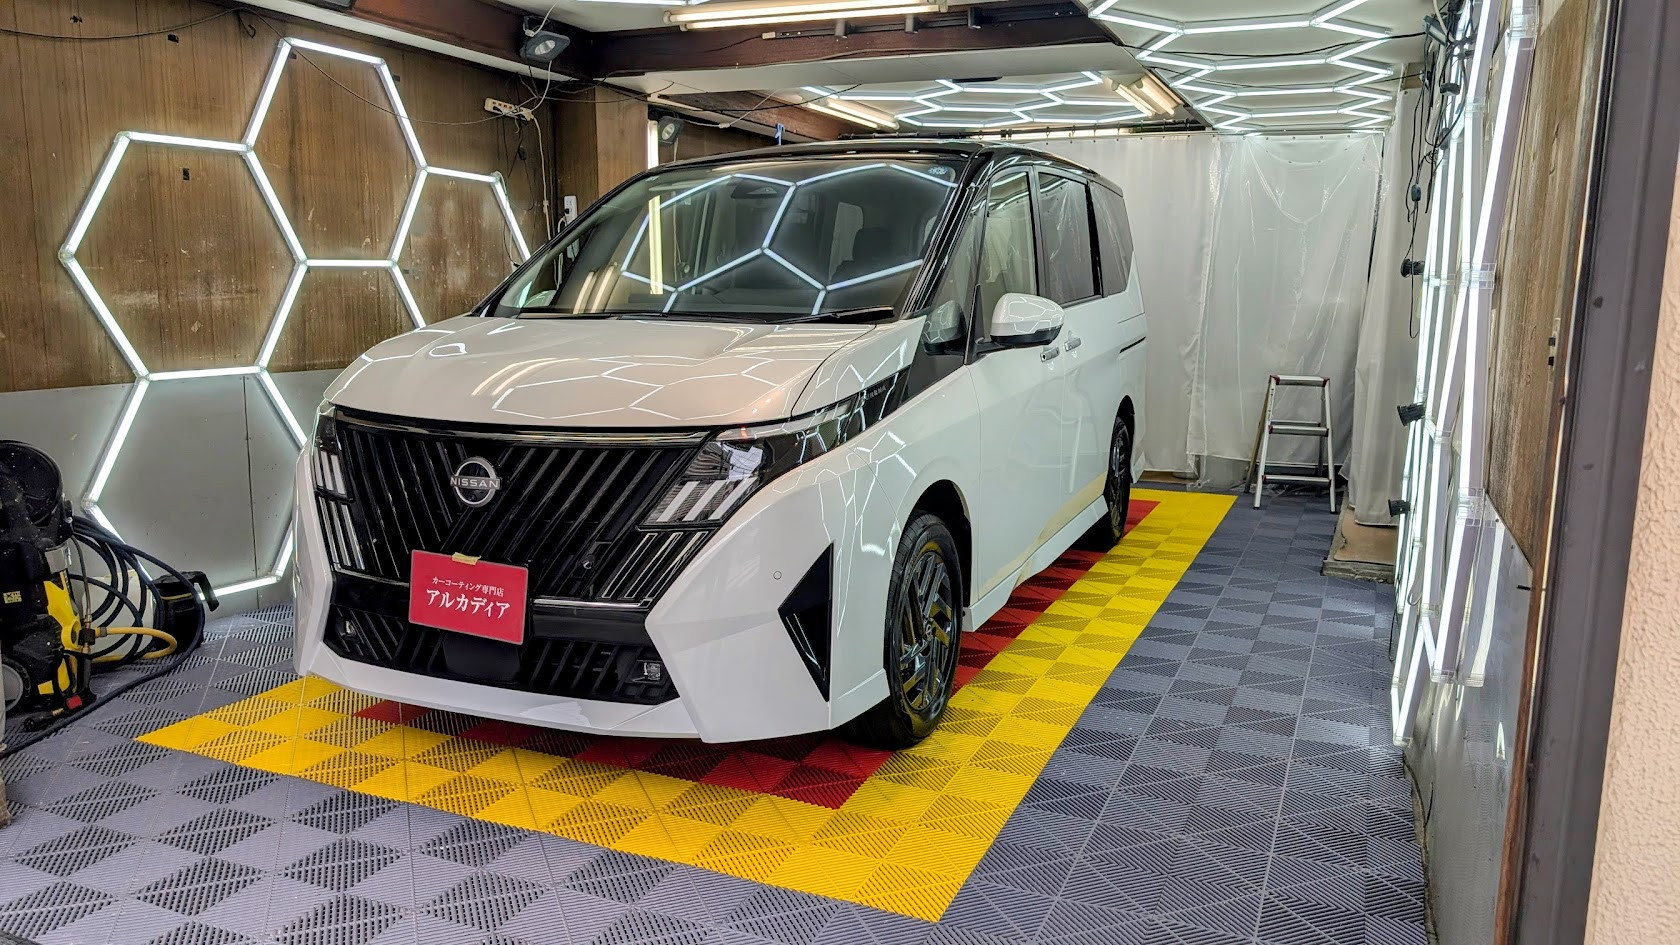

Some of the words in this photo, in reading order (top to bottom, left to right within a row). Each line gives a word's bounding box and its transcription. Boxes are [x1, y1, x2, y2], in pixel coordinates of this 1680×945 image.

[450, 477, 499, 488] NISSAN
[432, 576, 504, 597] カーコーティング専門店
[426, 588, 511, 619] アルカディア
